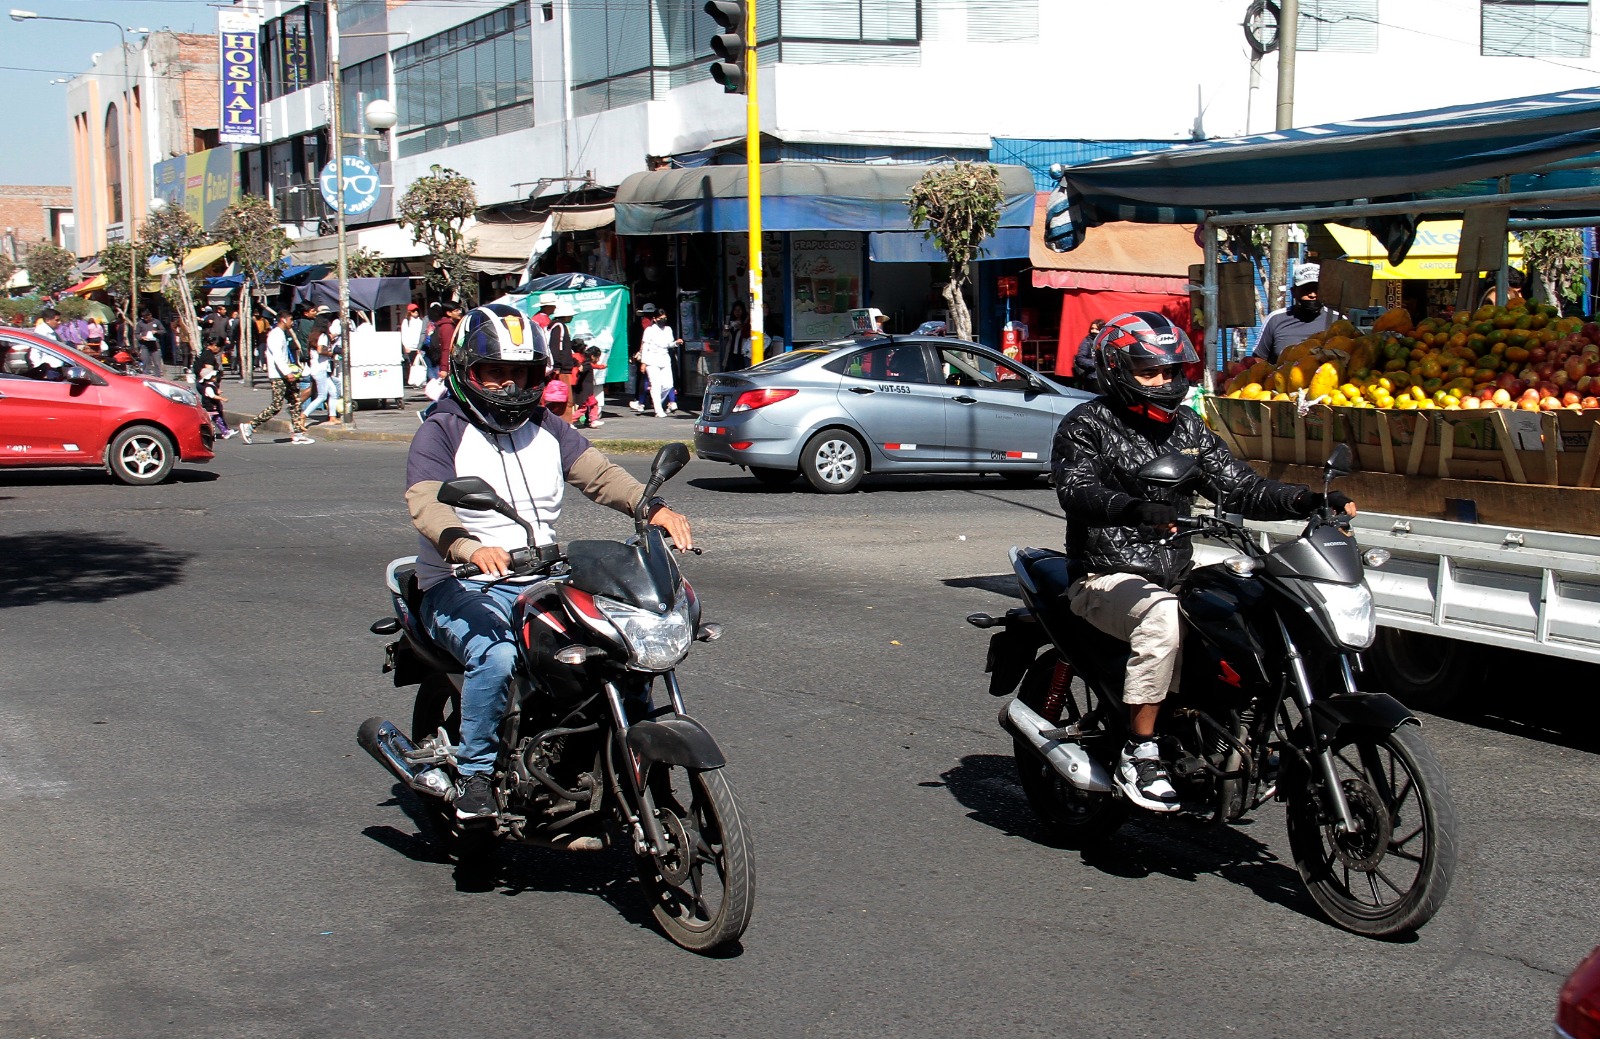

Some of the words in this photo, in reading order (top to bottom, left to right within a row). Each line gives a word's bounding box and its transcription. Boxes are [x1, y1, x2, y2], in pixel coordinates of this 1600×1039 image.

[224, 34, 254, 125] HOSTAL
[328, 157, 371, 175] OTICA
[348, 194, 375, 212] JUAN
[878, 384, 911, 394] V9T-553
